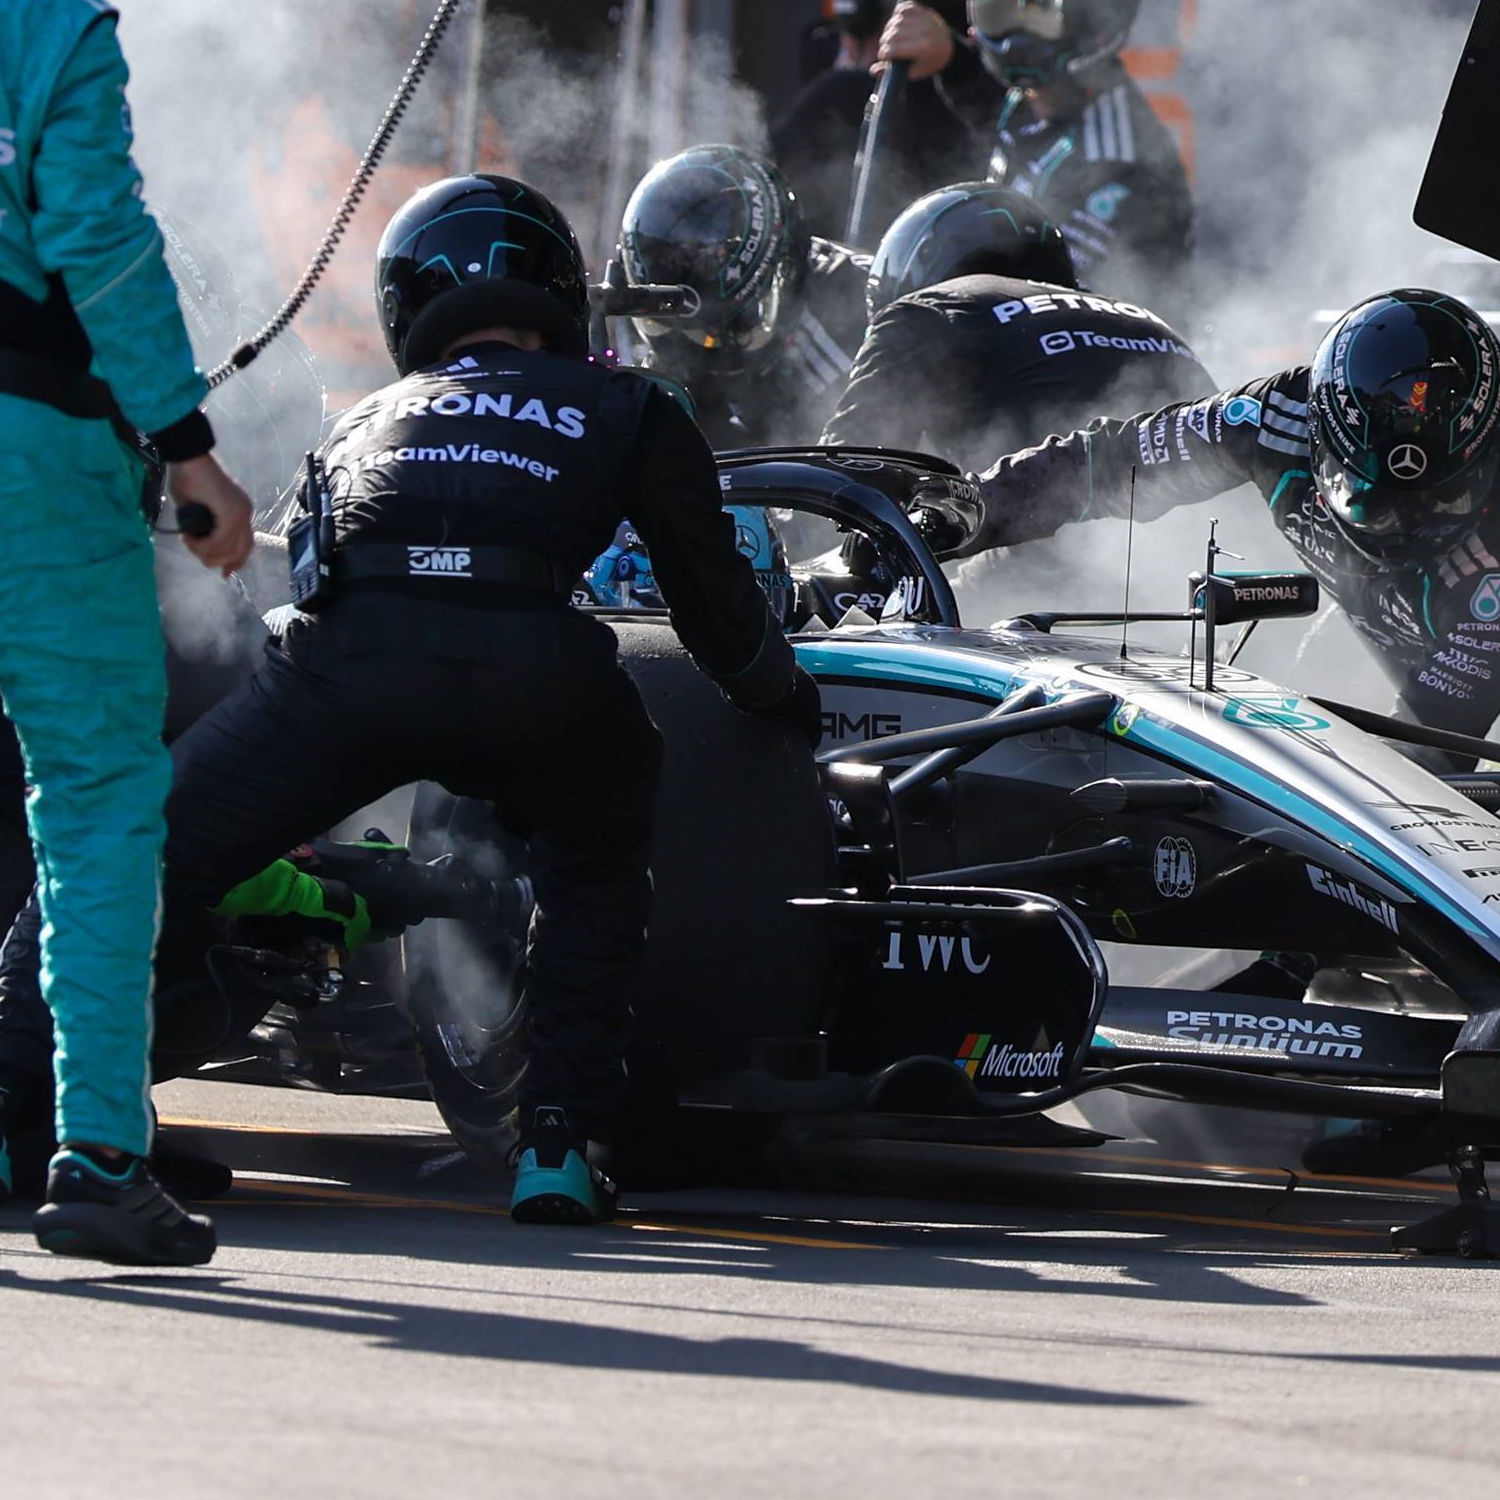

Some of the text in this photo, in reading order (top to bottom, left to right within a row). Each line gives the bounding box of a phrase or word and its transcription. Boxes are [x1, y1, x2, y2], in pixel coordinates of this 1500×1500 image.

[739, 189, 765, 266] SOLERA
[992, 294, 1173, 324] PETRO
[1332, 331, 1350, 408] SOLERA
[1473, 337, 1493, 413] SOLERA
[363, 443, 560, 483] TeamViewer
[408, 550, 472, 572] OMP
[1233, 585, 1300, 602] PETRONAS
[1305, 863, 1400, 934] Einhell
[1167, 1010, 1363, 1039] PETRONAS
[1167, 1025, 1364, 1059] Syntium
[980, 1040, 1066, 1079] Microsoft
